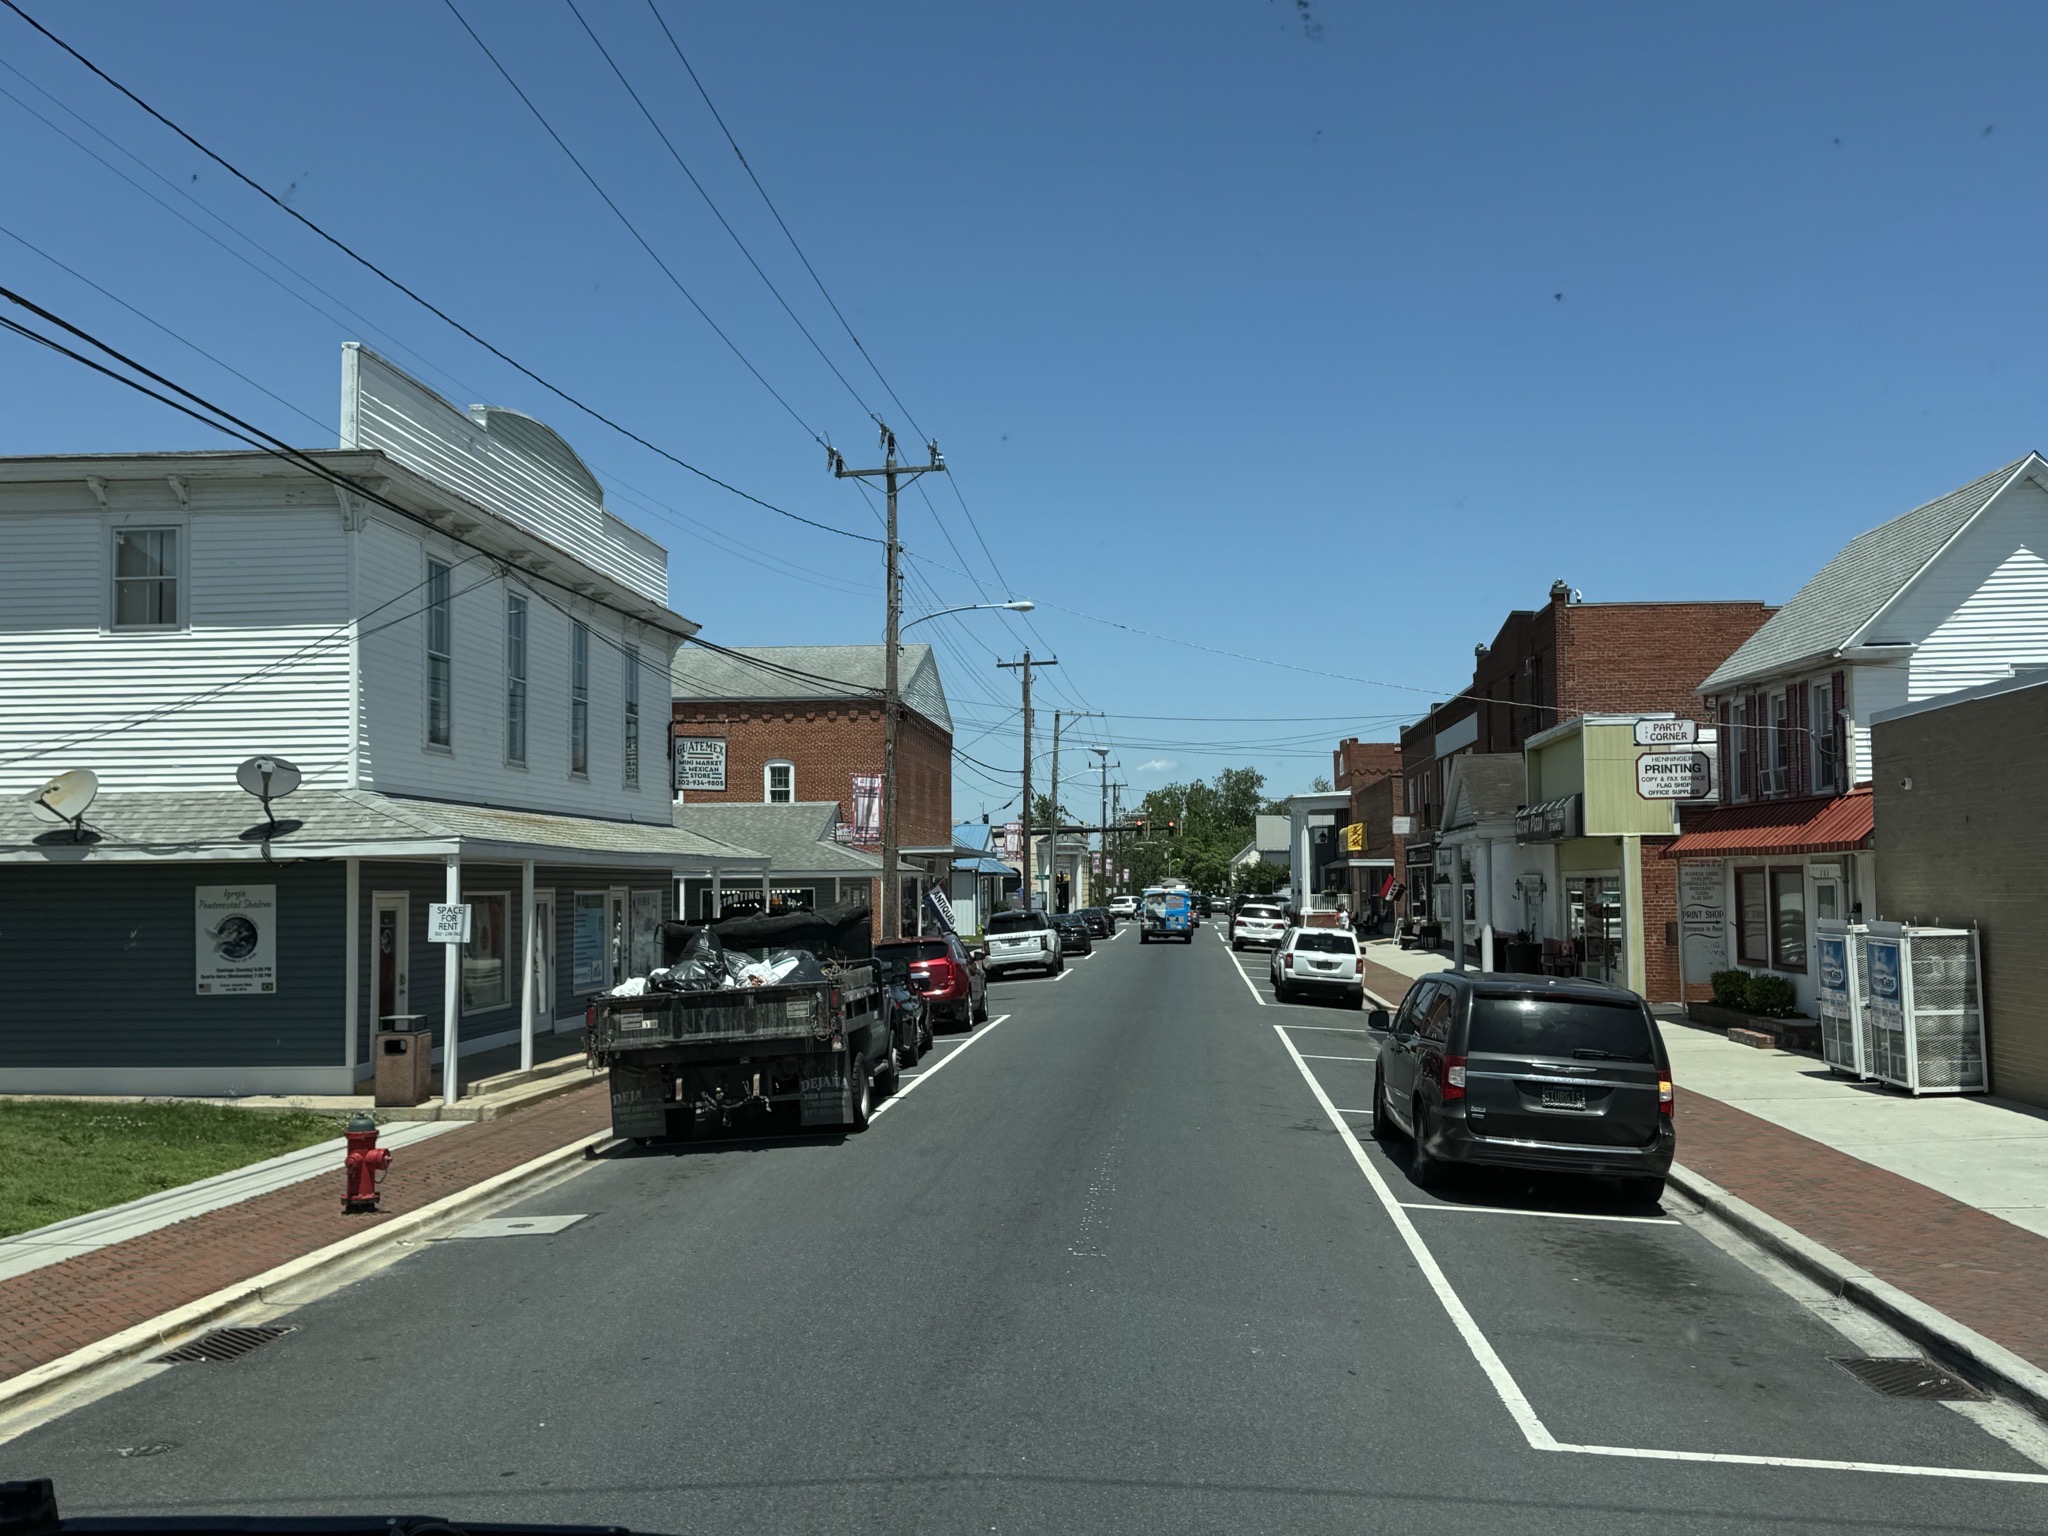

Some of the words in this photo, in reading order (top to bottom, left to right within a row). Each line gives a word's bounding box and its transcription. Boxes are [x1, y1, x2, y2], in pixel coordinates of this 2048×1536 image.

[1653, 723, 1684, 732] PARTY
[1650, 732, 1687, 741] CORNER
[677, 741, 724, 756] GUATEMEX
[1644, 763, 1702, 774] PRINTING
[437, 906, 464, 914] SPACE
[933, 890, 956, 926] ANTIQUES
[1682, 910, 1702, 919] PRINT
[1705, 910, 1724, 919] SHOP
